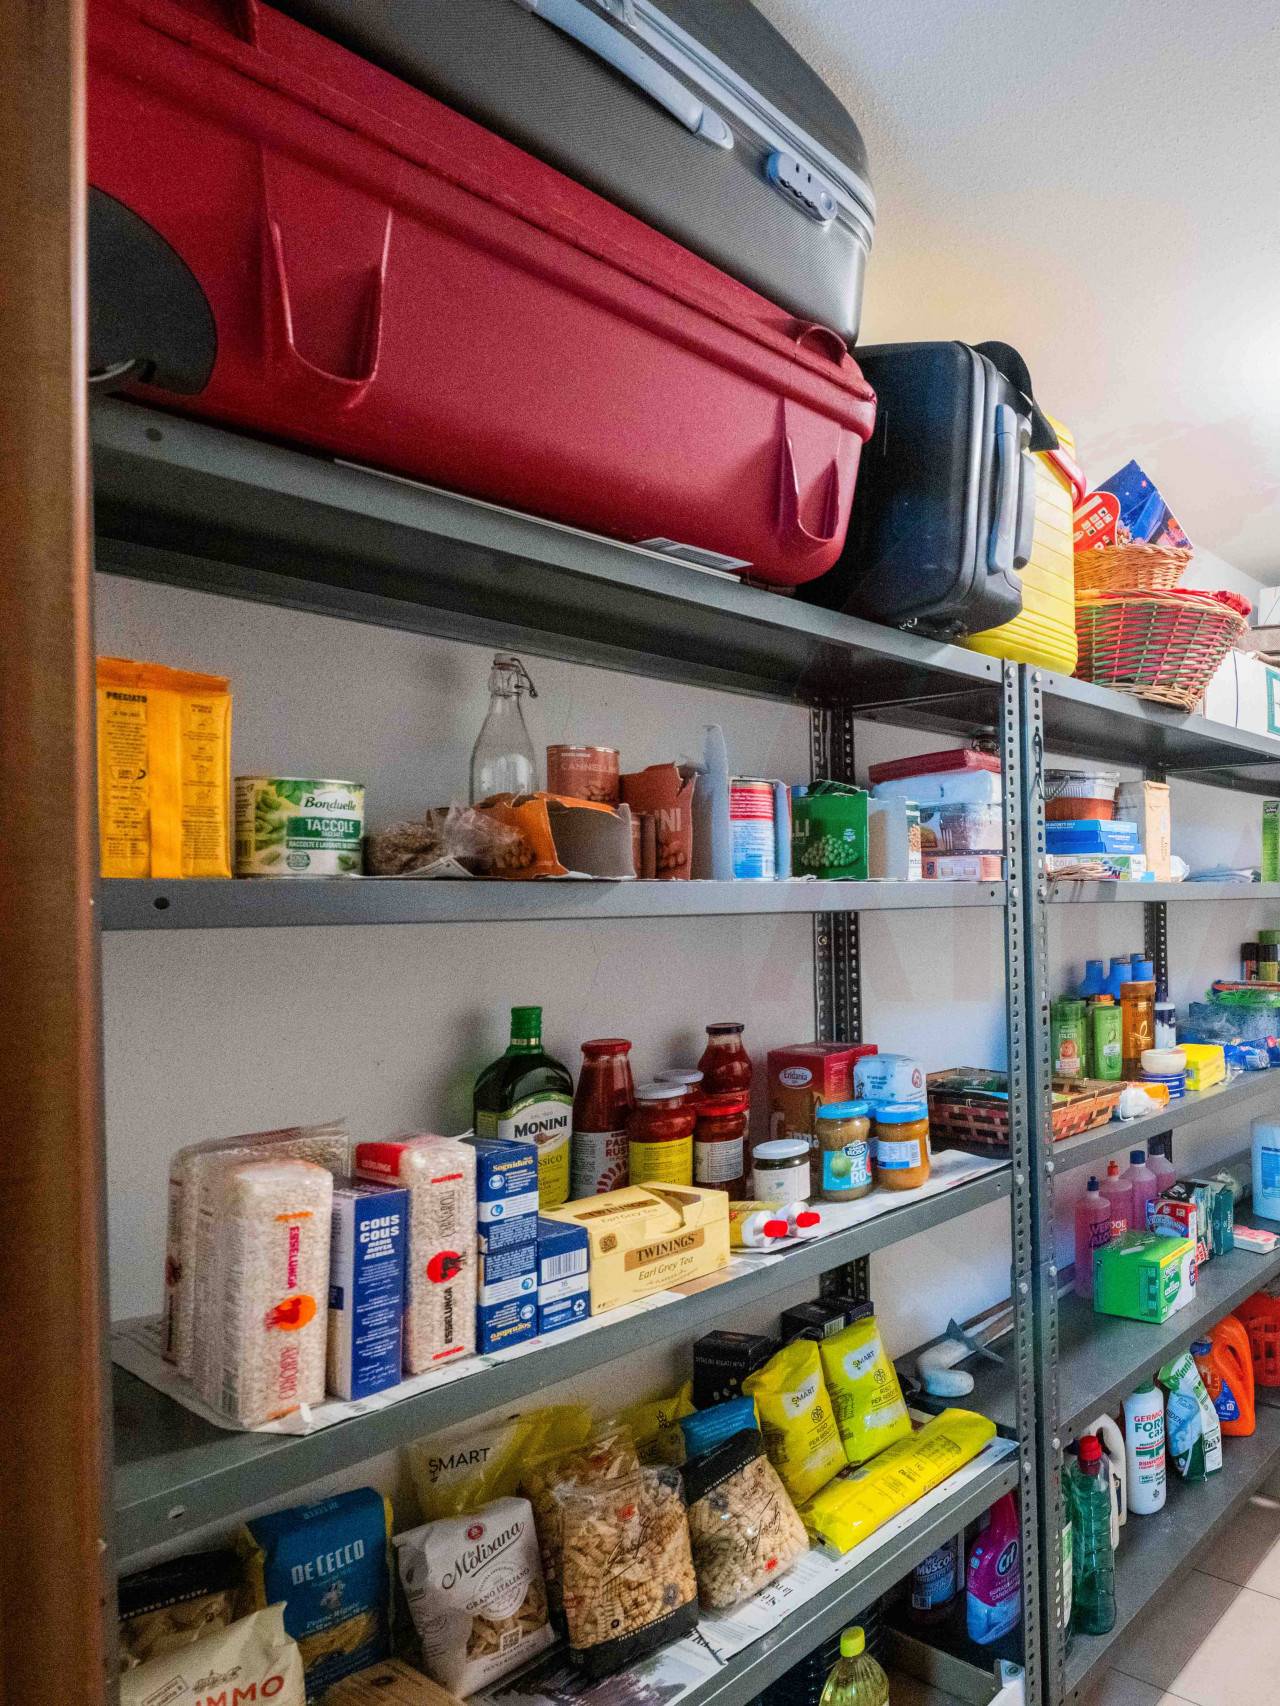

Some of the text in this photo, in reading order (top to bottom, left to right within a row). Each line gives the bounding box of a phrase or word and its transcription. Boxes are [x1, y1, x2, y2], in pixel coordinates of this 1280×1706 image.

[304, 796, 357, 812] Bonduelle
[305, 819, 354, 833] TACCOLE
[514, 1115, 568, 1139] MONINI
[359, 1226, 400, 1243] COUS
[360, 1214, 400, 1232] COUS
[287, 1226, 300, 1290] ESSELUNGA
[636, 1236, 696, 1262] TWININGS
[638, 1267, 657, 1281] Earl
[657, 1262, 677, 1275] Grey
[679, 1255, 694, 1266] Tea
[443, 1287, 454, 1344] ESSELUNGA
[852, 1350, 875, 1368] SMART
[791, 1386, 816, 1405] SMART
[428, 1447, 491, 1475] SMART
[291, 1539, 365, 1586] DE CECCO
[441, 1521, 525, 1590] Molisana
[998, 1541, 1017, 1575] Cif
[466, 1567, 531, 1611] GRANO ITALIANO
